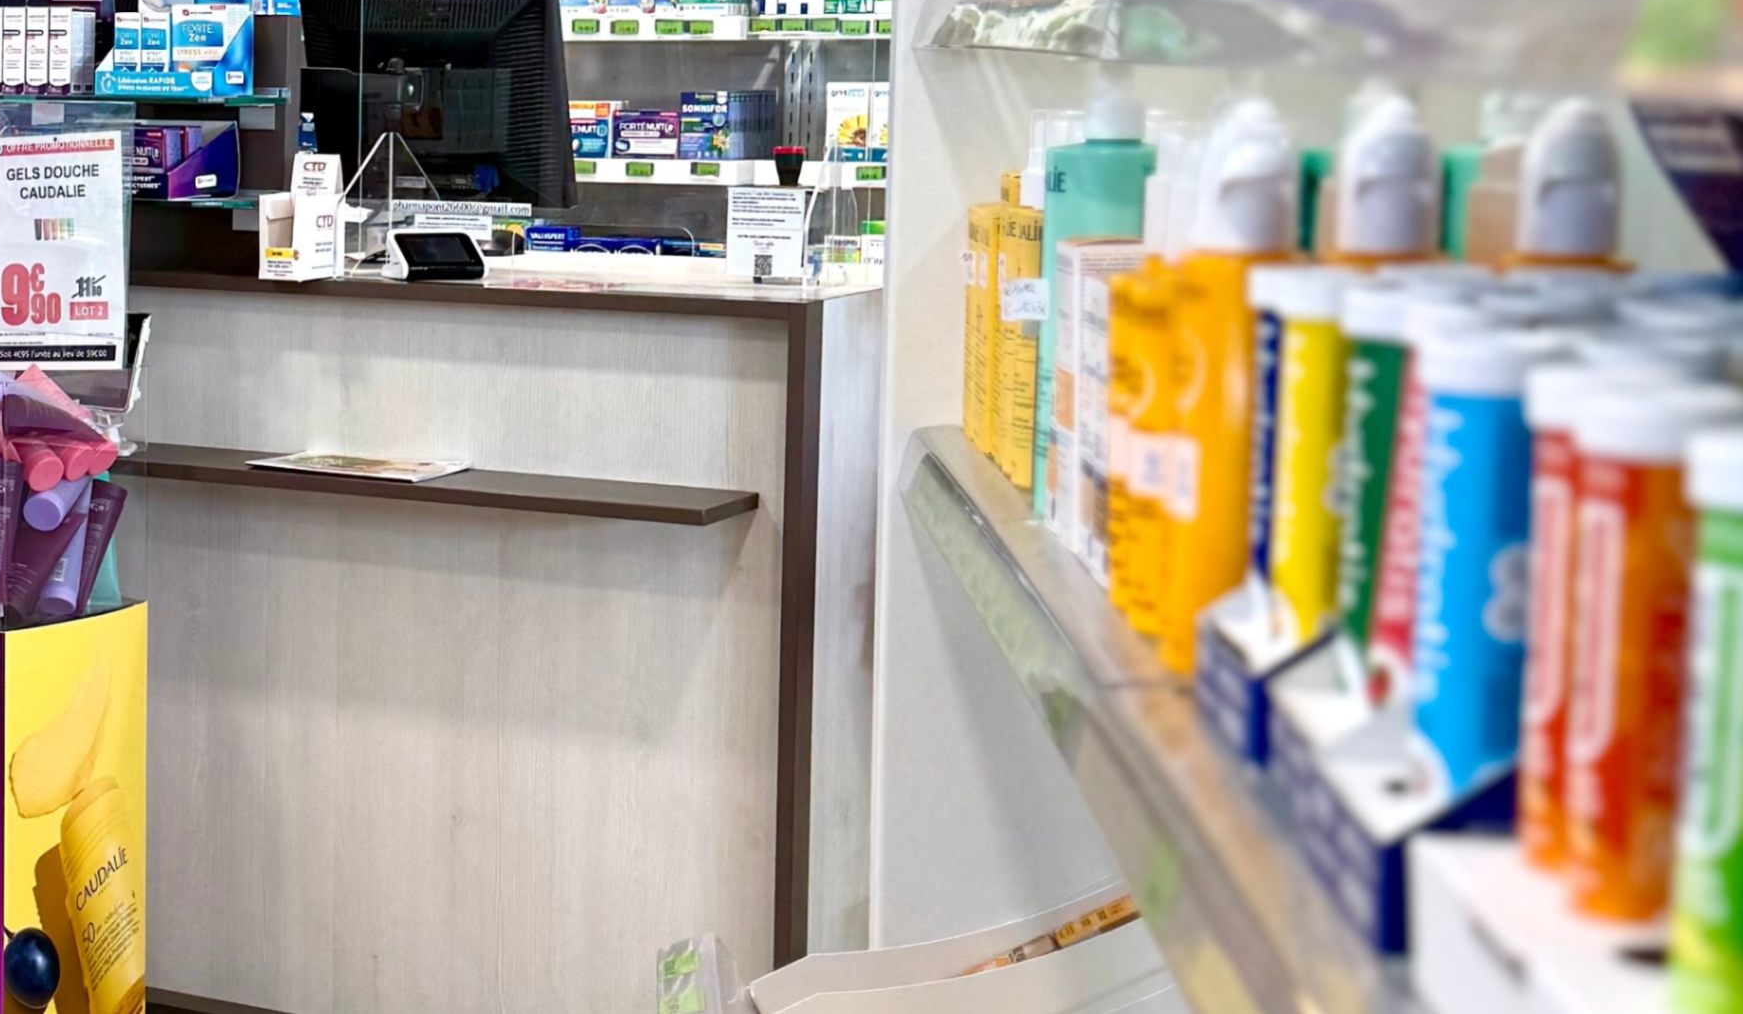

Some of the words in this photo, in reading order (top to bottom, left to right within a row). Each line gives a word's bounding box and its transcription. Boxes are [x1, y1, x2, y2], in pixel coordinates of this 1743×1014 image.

[682, 103, 728, 113] SOMNIFOR
[6, 166, 40, 181] GELS
[44, 164, 100, 179] DOUCHE
[19, 184, 86, 200] CAUDALIE
[75, 306, 94, 316] LOT
[97, 306, 104, 315] 2
